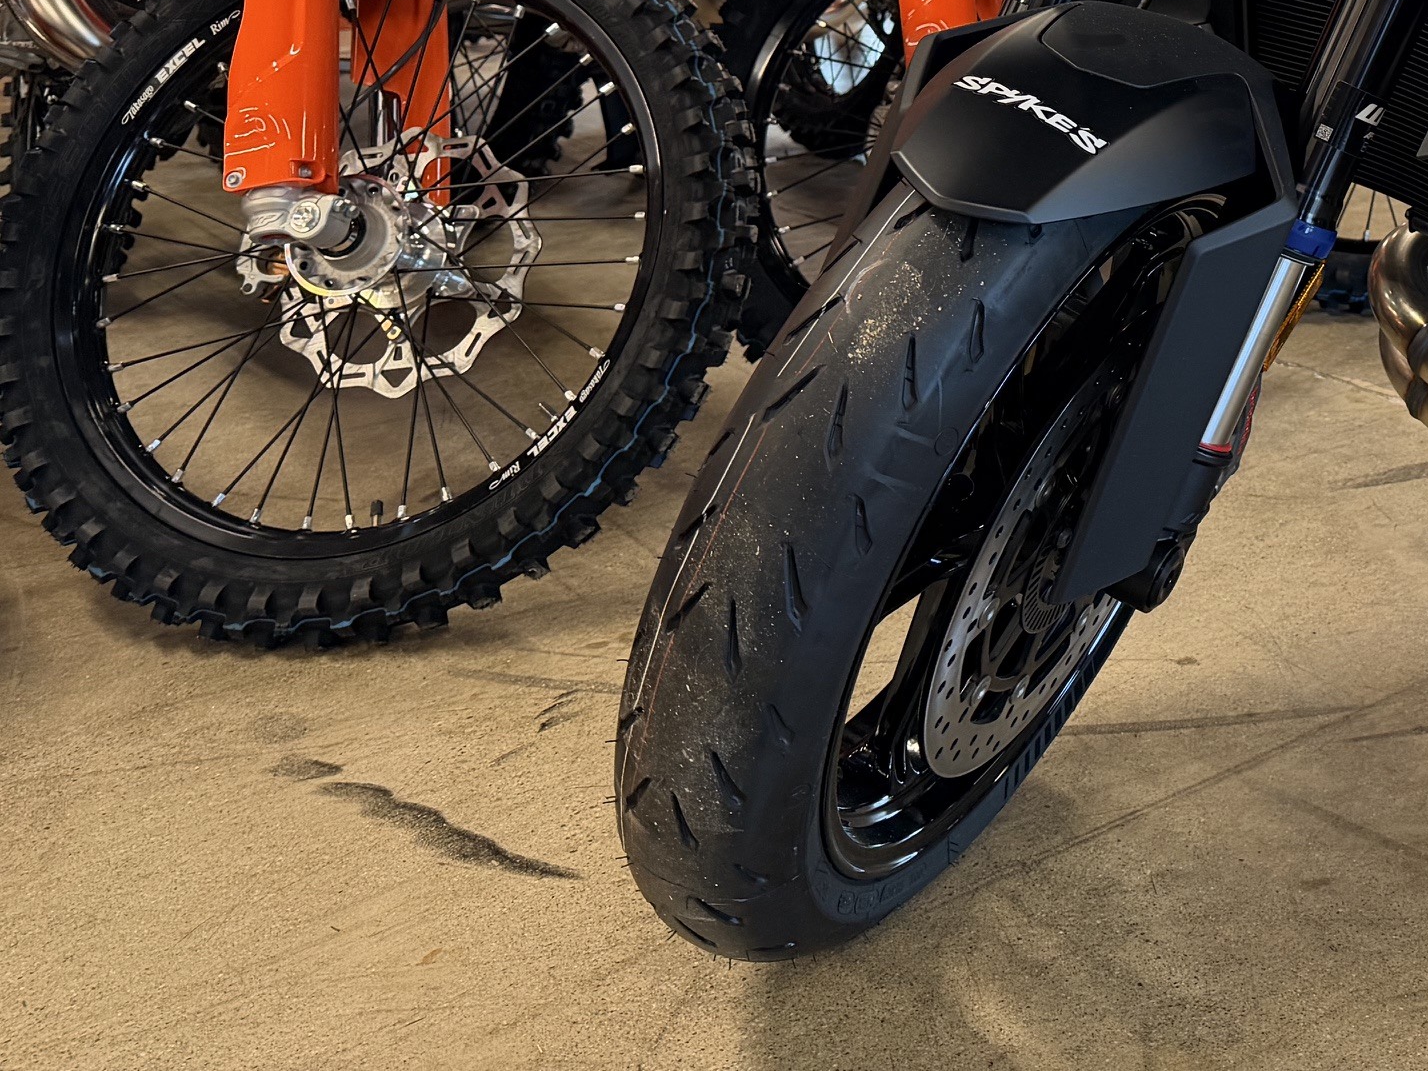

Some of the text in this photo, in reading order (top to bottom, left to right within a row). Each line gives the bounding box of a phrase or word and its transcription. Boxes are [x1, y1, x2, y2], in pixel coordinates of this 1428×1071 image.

[154, 37, 206, 84] EXCEL
[953, 75, 1109, 155] SPYKE'S
[526, 405, 578, 458] EXCEL
